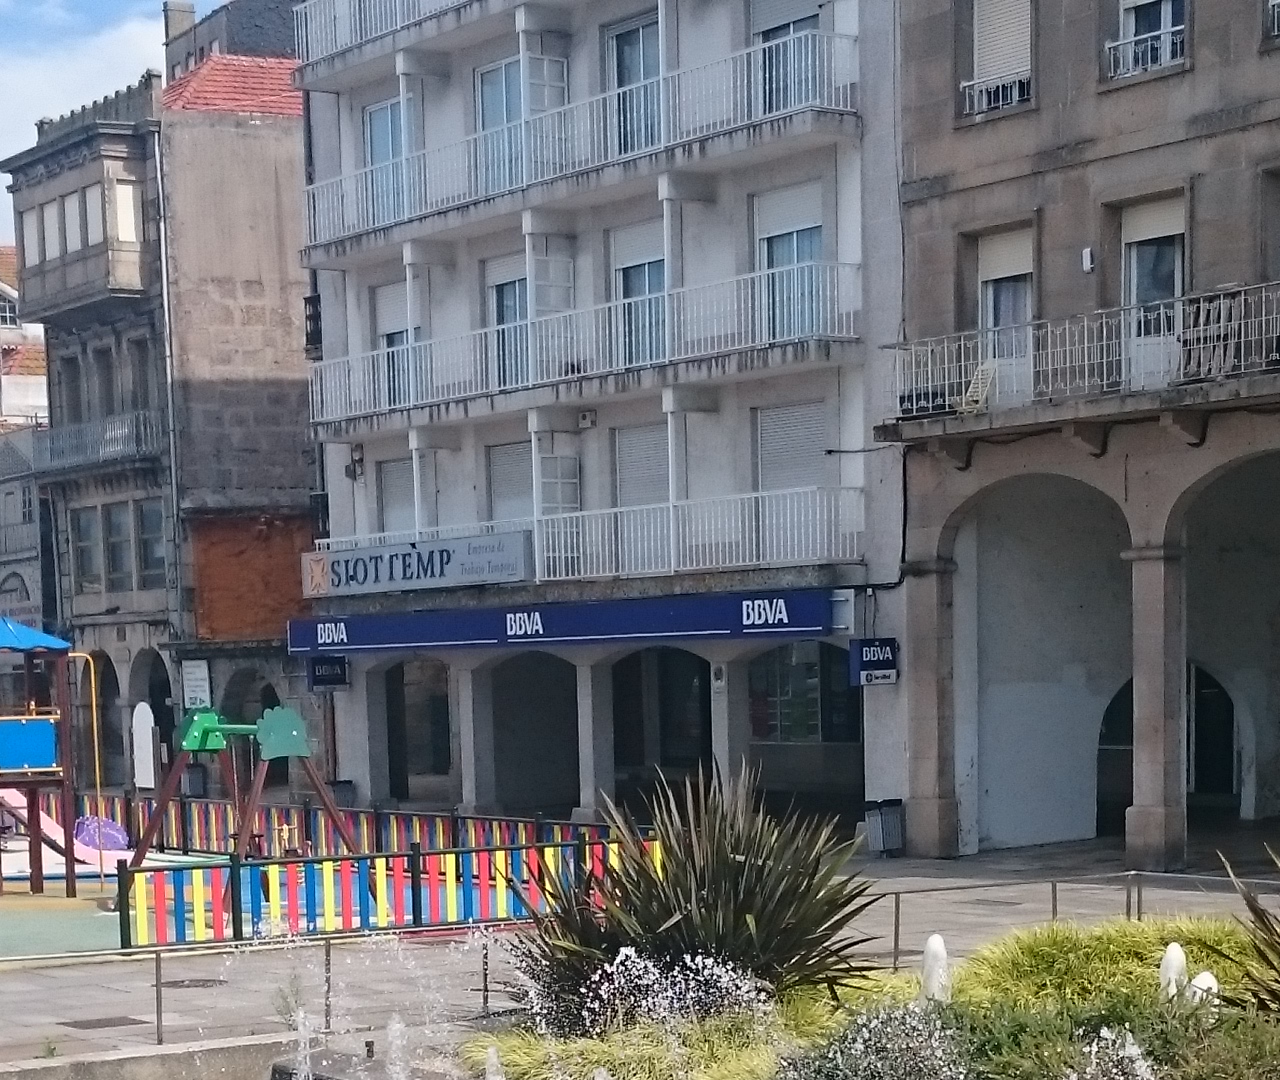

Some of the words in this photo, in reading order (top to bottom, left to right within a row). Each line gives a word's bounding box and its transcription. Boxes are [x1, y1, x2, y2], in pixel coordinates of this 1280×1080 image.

[506, 611, 544, 636] BBVA
[742, 598, 789, 626] BBVA
[317, 622, 348, 644] BBVA
[862, 646, 893, 661] BBVA
